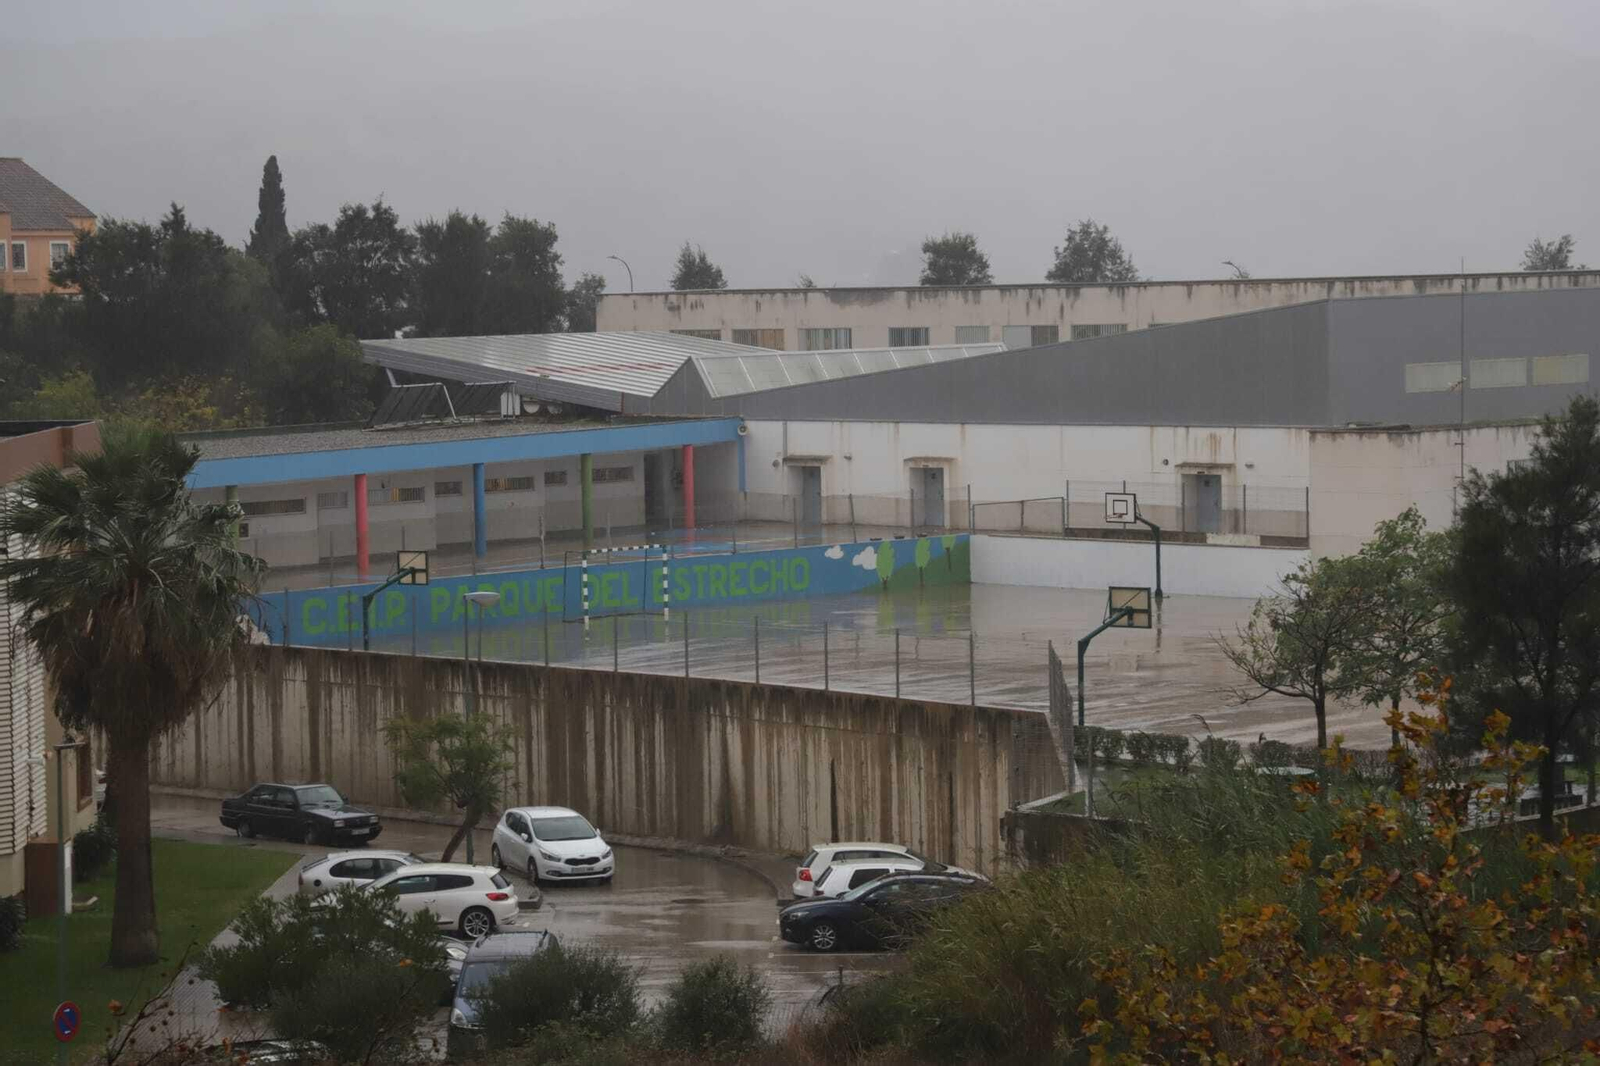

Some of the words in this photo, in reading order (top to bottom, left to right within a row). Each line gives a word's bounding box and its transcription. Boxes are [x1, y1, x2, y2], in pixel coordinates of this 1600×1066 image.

[302, 591, 406, 635] C.EI.P.
[430, 576, 564, 624] PARQUE
[583, 571, 638, 609] DEL
[653, 557, 810, 603] ESTRECHO
